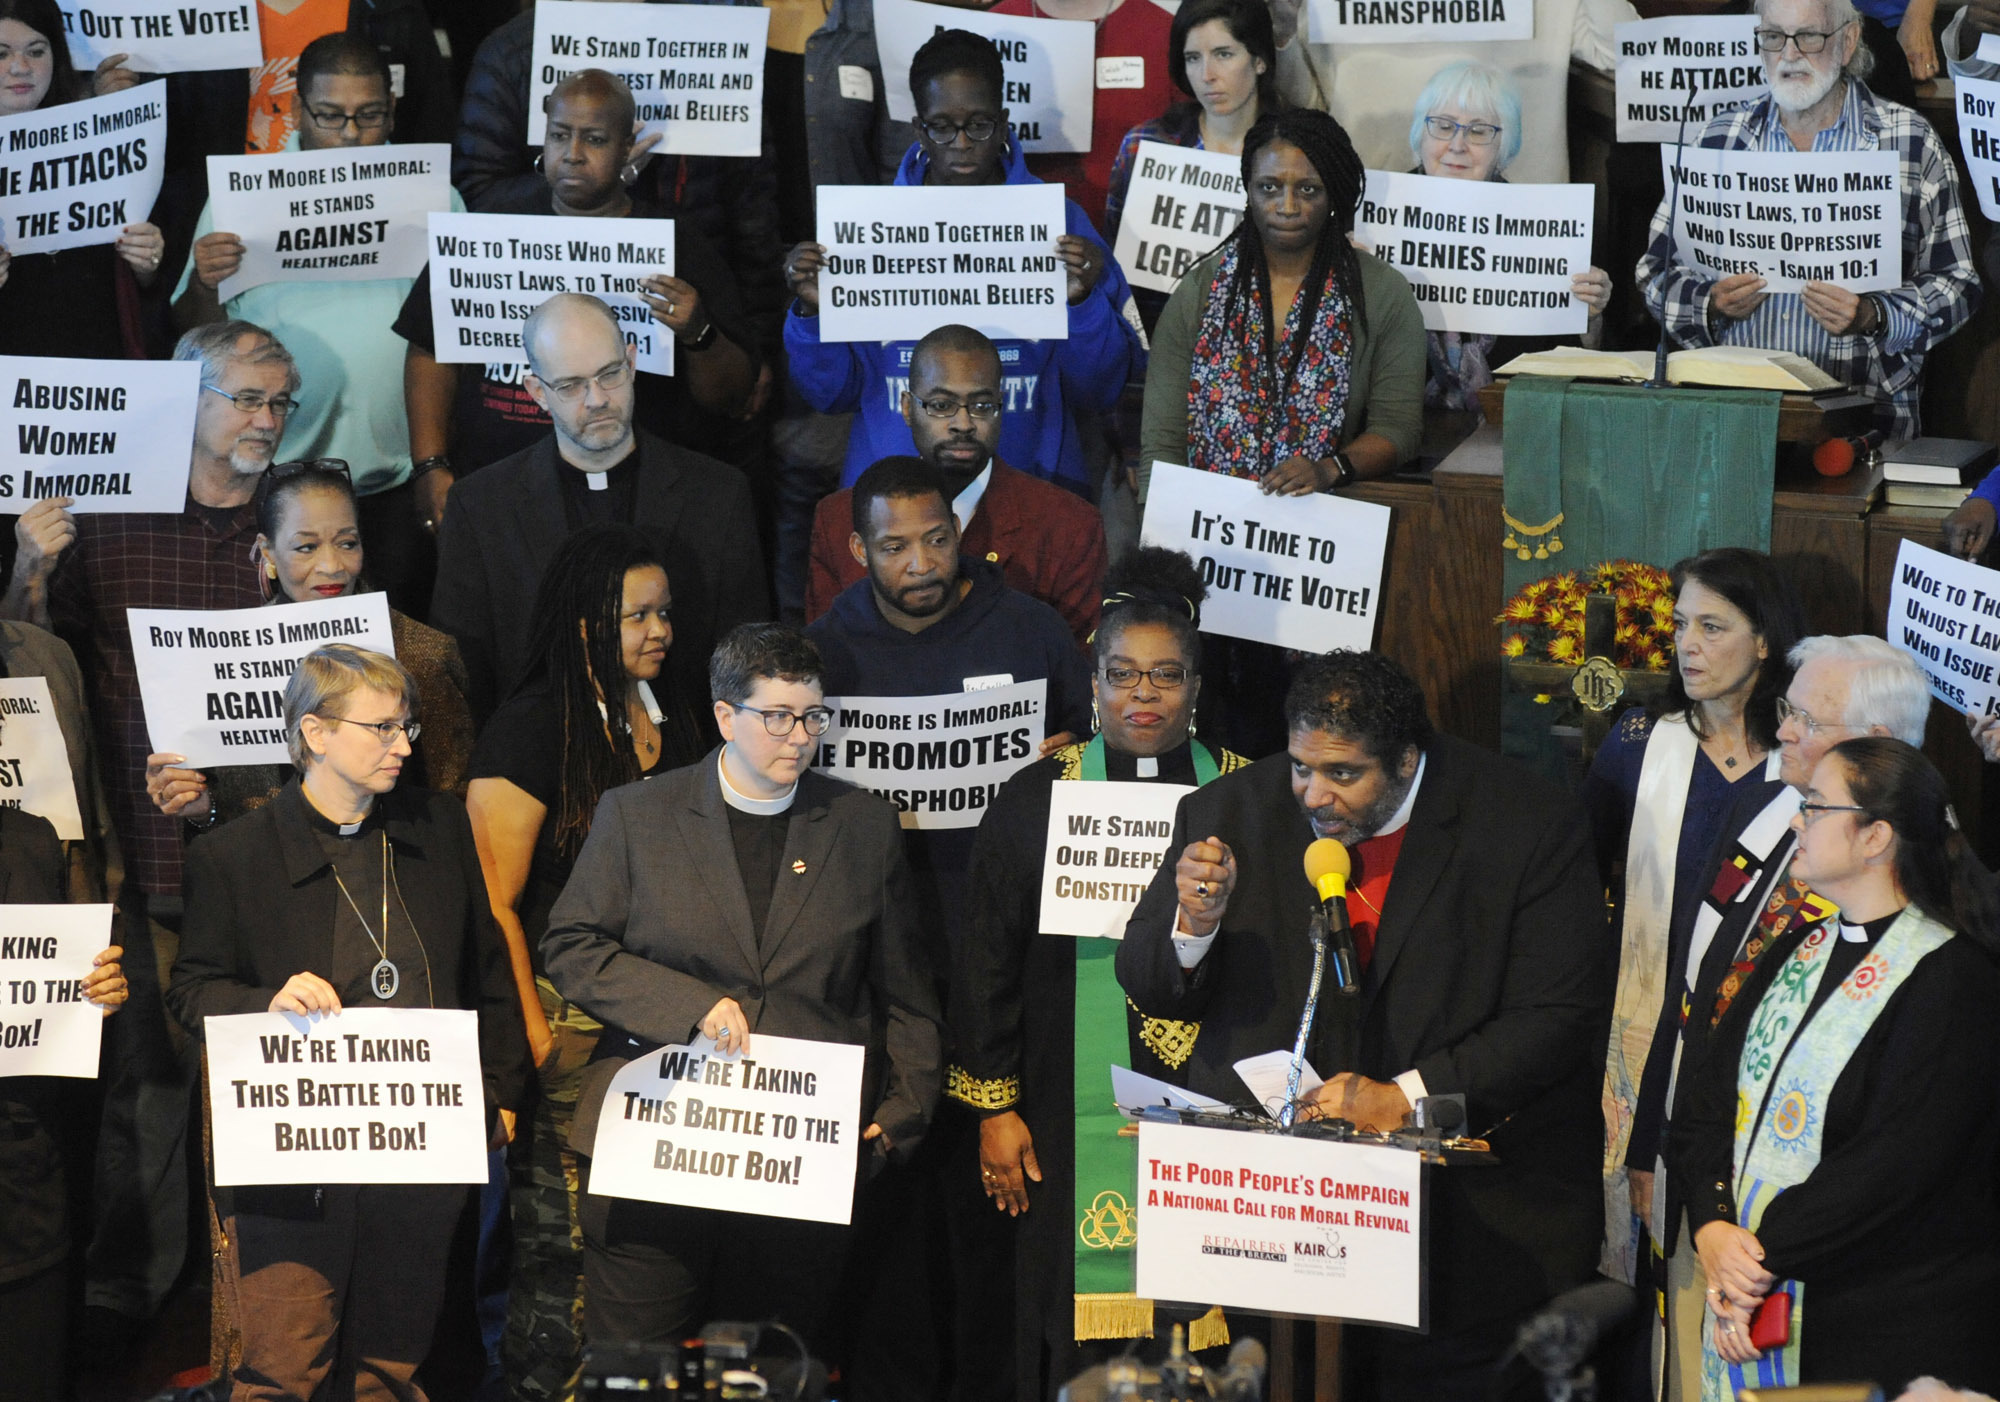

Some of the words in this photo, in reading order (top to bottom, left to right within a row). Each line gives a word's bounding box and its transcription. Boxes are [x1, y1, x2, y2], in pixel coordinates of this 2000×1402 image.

[80, 9, 123, 38] OUT
[131, 16, 173, 38] THE
[178, 6, 249, 35] VOTE!
[1336, 0, 1505, 24] TRANSPHOBIA
[552, 35, 579, 56] WE
[587, 37, 640, 58] STAND
[647, 38, 727, 58] TOGETHER
[733, 44, 748, 58] IN
[1622, 41, 1656, 56] ROY
[1664, 37, 1725, 57] MOORE
[1732, 41, 1747, 56] IS
[660, 70, 714, 89] MORAL
[721, 74, 752, 89] AND
[1642, 71, 1663, 89] HE
[686, 100, 748, 122] BELIEFS
[1963, 93, 1995, 118] ROY
[10, 125, 68, 152] MOORE
[74, 121, 87, 140] IS
[93, 102, 160, 135] IMMORAL:
[29, 138, 147, 193] ATTACKS
[229, 172, 262, 191] ROY
[269, 169, 326, 188] MOORE
[332, 167, 346, 182] IS
[352, 160, 430, 180] IMMORAL:
[1141, 157, 1177, 181] ROY
[1712, 174, 1731, 190] TO
[1736, 172, 1789, 192] THOSE
[1795, 174, 1837, 192] WHO
[1844, 173, 1892, 191] MAKE
[17, 211, 59, 238] THE
[68, 200, 126, 231] SICK
[290, 201, 308, 217] HE
[314, 194, 374, 215] STANDS
[1151, 195, 1186, 229] HE
[1363, 201, 1397, 225] ROY
[1404, 206, 1466, 232] MOORE
[1473, 217, 1489, 234] IS
[1496, 214, 1584, 237] IMMORAL:
[1683, 195, 1741, 219] UNJUST
[1747, 202, 1796, 224] LAWS,
[1802, 207, 1821, 222] TO
[1827, 203, 1881, 221] THOSE
[275, 220, 388, 252] AGAINST
[835, 222, 865, 243] WE
[872, 222, 929, 243] STAND
[935, 222, 1024, 242] TOGETHER
[1031, 225, 1047, 241] IN
[1686, 221, 1724, 245] WHO
[1730, 229, 1775, 249] ISSUE
[1781, 232, 1881, 251] OPPRESSIVE
[282, 252, 378, 268] HEALTHCARE
[437, 236, 477, 257] WOE
[483, 242, 502, 258] TO
[508, 239, 562, 260] THOSE
[568, 241, 610, 262] WHO
[618, 243, 665, 264] MAKE
[828, 255, 866, 275] OUR
[873, 255, 947, 274] DEEPEST
[954, 254, 1016, 273] MORAL
[1022, 256, 1056, 272] AND
[1135, 241, 1208, 279] LGB
[1375, 243, 1395, 264] HE
[1401, 240, 1485, 271] DENIES
[1492, 256, 1567, 275] FUNDING
[450, 268, 512, 289] UNJUST
[575, 277, 595, 292] TO
[601, 274, 652, 293] THOS
[1780, 260, 1834, 281] ISAIAH
[1840, 259, 1877, 279] 10:1
[451, 299, 494, 318] WHO
[832, 286, 980, 307] CONSTITUTIONAL
[987, 284, 1054, 304] BELIEFS
[1473, 288, 1570, 308] EDUCATION
[459, 328, 523, 347] DECREE
[13, 379, 126, 411] ABUSING
[19, 425, 116, 455] WOMEN
[22, 470, 132, 500] IMMORAL
[1191, 510, 1235, 545] IT'S
[1244, 520, 1300, 557] TIME
[1308, 537, 1335, 564] TO
[1253, 572, 1293, 601] THE
[1302, 576, 1370, 616] VOTE!
[1903, 564, 1941, 597] WOE
[1946, 585, 1966, 606] TO
[150, 626, 182, 647] ROY
[188, 628, 251, 648] MOORE
[256, 628, 273, 645] IS
[279, 617, 368, 643] IMMORAL:
[1906, 598, 1968, 640] UNJUST
[1904, 626, 1940, 661] WHO
[1944, 648, 1994, 683] ISSUE
[215, 663, 236, 679] HE
[1, 697, 40, 715] ORAL:
[206, 690, 284, 720] AGAIN
[840, 709, 911, 730] MOORE
[919, 714, 936, 730] IS
[944, 700, 1037, 728] IMMORAL:
[220, 729, 288, 745] HEALTHC
[846, 728, 1030, 770] PROMOTES
[1069, 816, 1101, 835] WE
[1107, 816, 1170, 837] STAND
[1057, 846, 1097, 866] OUR
[1104, 846, 1162, 869] DEEPE
[2, 937, 57, 959] KING
[9, 981, 36, 1004] TO
[45, 979, 82, 1003] THE
[260, 1034, 336, 1063] WE'RE
[343, 1035, 430, 1062] TAKING
[659, 1052, 732, 1086] WE'RE
[741, 1059, 816, 1096] TAKING
[232, 1080, 289, 1108] THIS
[297, 1079, 380, 1106] BATTLE
[387, 1083, 414, 1106] TO
[422, 1084, 463, 1106] THE
[624, 1092, 676, 1124] THIS
[684, 1098, 765, 1136] BATTLE
[772, 1114, 797, 1139] TO
[805, 1118, 839, 1144] THE
[275, 1123, 360, 1151] BALLOT
[368, 1122, 426, 1150] BOX!
[654, 1140, 739, 1178] BALLOT
[745, 1151, 802, 1185] BOX!
[1149, 1160, 1181, 1182] THE
[1188, 1163, 1233, 1187] POOR
[1240, 1168, 1314, 1196] PEOPLE'S
[1321, 1177, 1409, 1207] CAMPAIGN
[1148, 1190, 1158, 1206] A
[1164, 1191, 1229, 1213] NATIONAL
[1234, 1198, 1266, 1217] CALL
[1271, 1205, 1295, 1220] FOR
[1301, 1205, 1350, 1225] MORAL
[1355, 1210, 1409, 1233] REVIVAL
[1204, 1235, 1286, 1253] REPAIRERS
[1220, 1248, 1239, 1257] THE
[1249, 1252, 1287, 1262] BREACH
